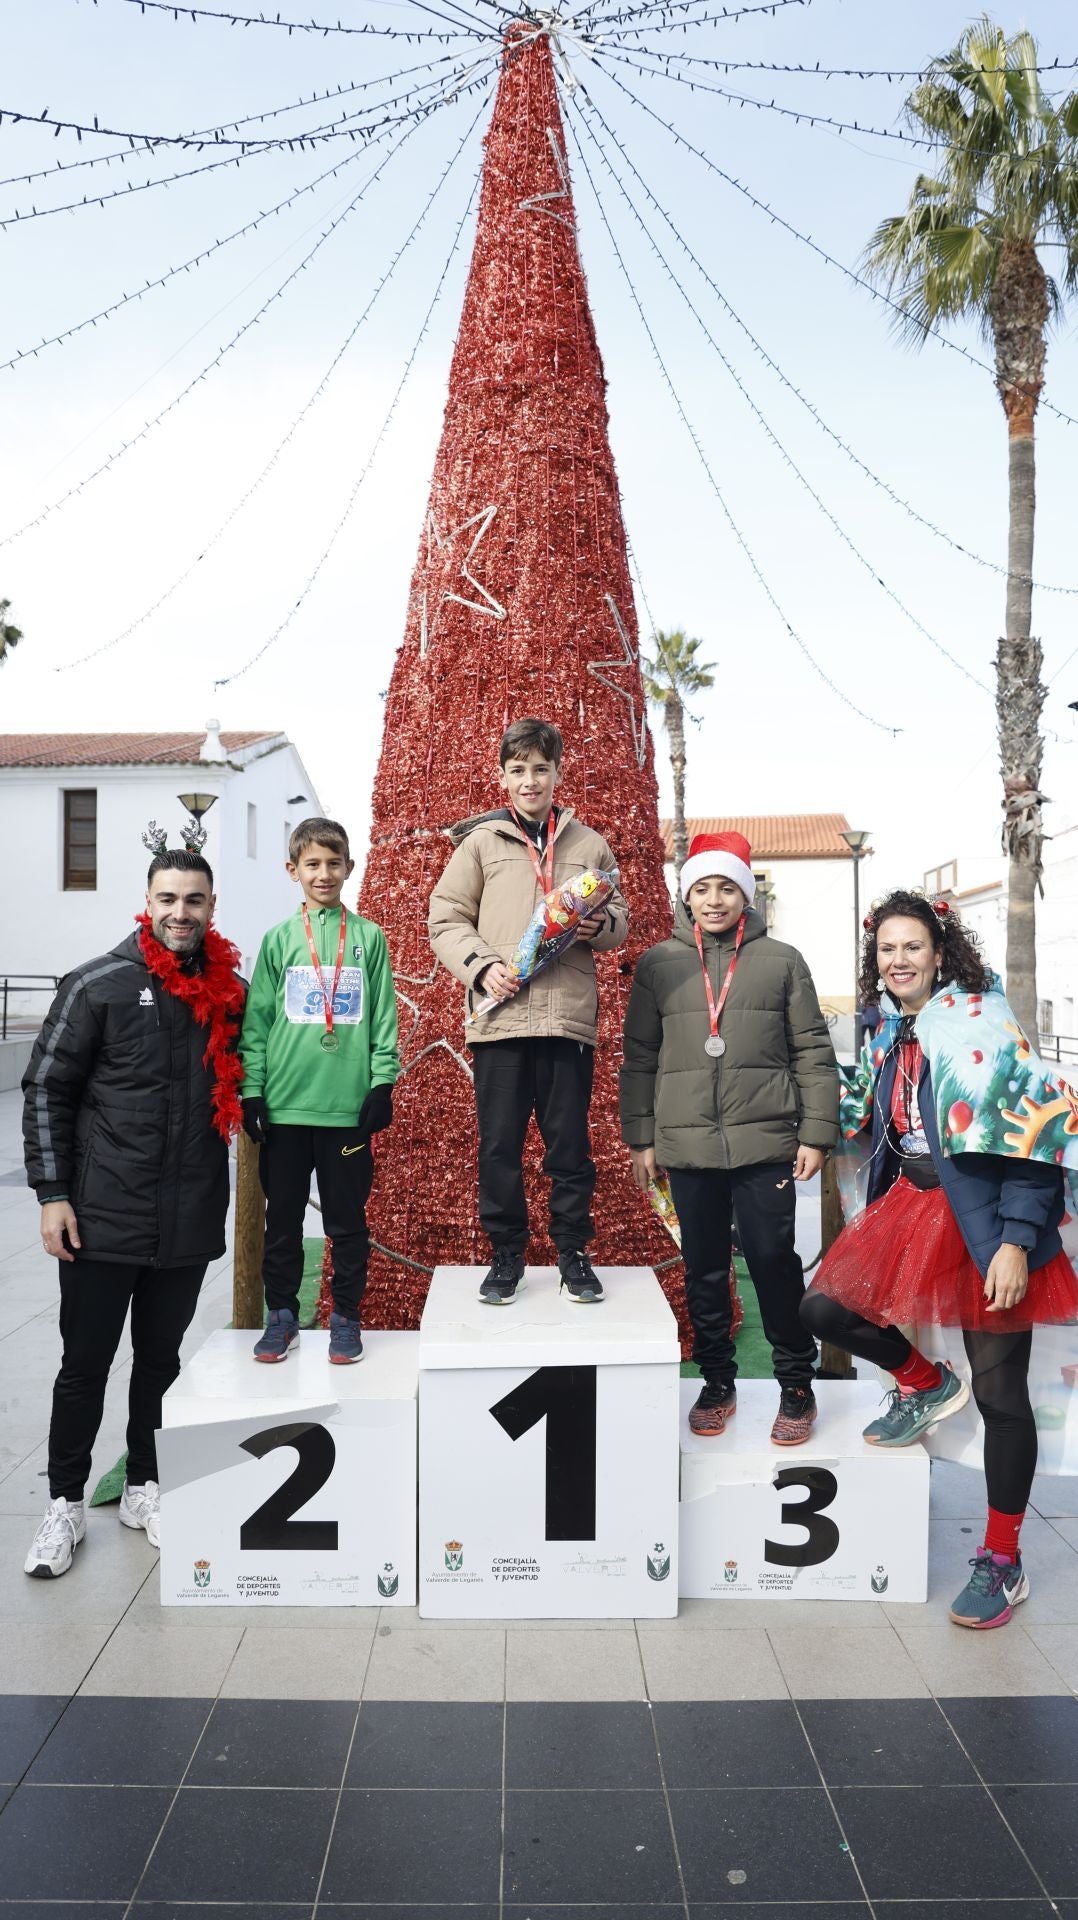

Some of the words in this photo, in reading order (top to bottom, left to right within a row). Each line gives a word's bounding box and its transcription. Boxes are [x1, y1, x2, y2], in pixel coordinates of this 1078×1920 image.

[303, 991, 352, 1015] 95
[489, 1365, 597, 1541] 1
[238, 1422, 338, 1550] 2
[764, 1466, 840, 1568] 3
[493, 1556, 537, 1565] CONCEJALÍA
[237, 1574, 278, 1582] CONCEJALÍA
[502, 1574, 538, 1582] JUVENTUD
